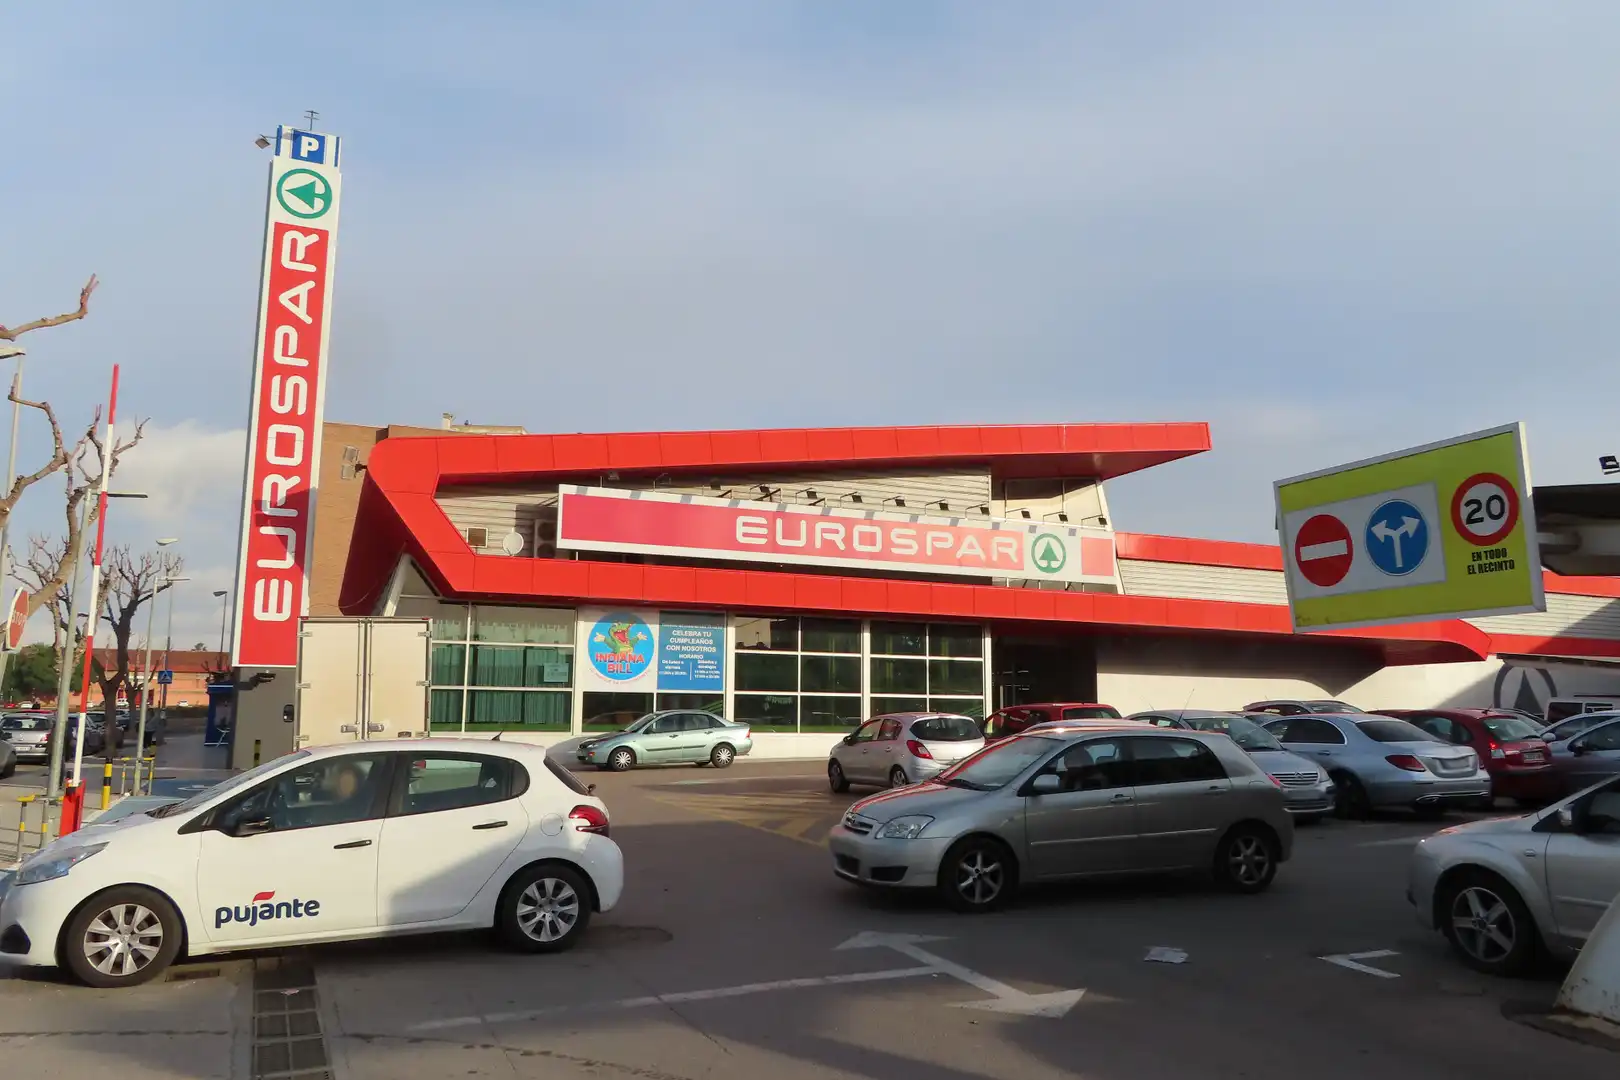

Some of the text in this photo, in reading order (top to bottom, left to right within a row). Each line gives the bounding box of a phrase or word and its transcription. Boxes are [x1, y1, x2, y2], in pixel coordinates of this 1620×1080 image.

[300, 135, 319, 158] P
[254, 229, 320, 622] EUROSPAR
[1464, 494, 1506, 525] 20
[736, 515, 1018, 563] EUROSPAR
[1471, 547, 1508, 562] EN TODO
[1467, 559, 1516, 575] EL RECINTO
[670, 637, 713, 645] CUMPLEAÑOS
[595, 652, 645, 664] INDIANA
[607, 663, 633, 674] BILL
[215, 898, 321, 929] pujante
